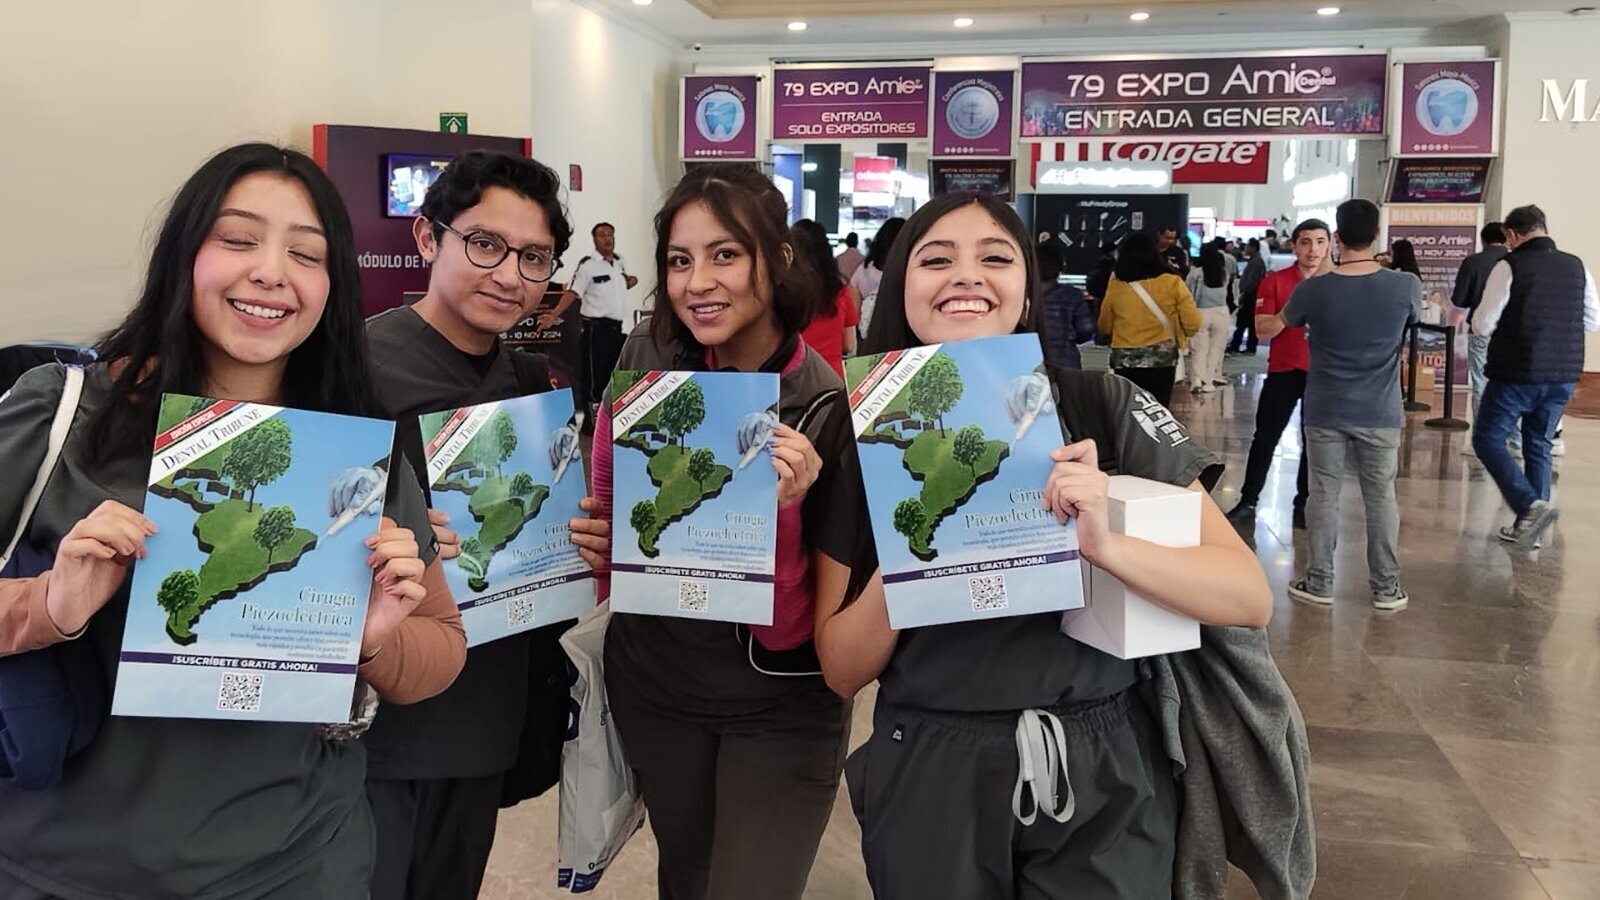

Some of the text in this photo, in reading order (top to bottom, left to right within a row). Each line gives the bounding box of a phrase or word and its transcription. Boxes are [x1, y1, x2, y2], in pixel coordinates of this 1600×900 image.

[783, 81, 804, 97] 79
[810, 80, 859, 96] EXPO
[1067, 73, 1106, 98] 79
[1117, 72, 1209, 97] EXPO
[821, 111, 882, 123] ENTRADA
[1065, 106, 1335, 129] ENTRADA GENERAL
[788, 122, 916, 135] SOLO EXPOSITORES
[1392, 209, 1473, 222] BIENVENIDOS
[404, 254, 420, 269] DE
[859, 352, 927, 421] DENTAL TRIBUNE
[161, 408, 262, 470] DENTAL TRIBUNE
[980, 560, 1012, 571] GRATIS
[1013, 555, 1047, 567] AHORA!
[691, 569, 716, 579] GRATIS
[718, 572, 746, 580] AHORA!
[172, 654, 319, 673] ¡SUSCRÍBETE GRATIS AHORA!
